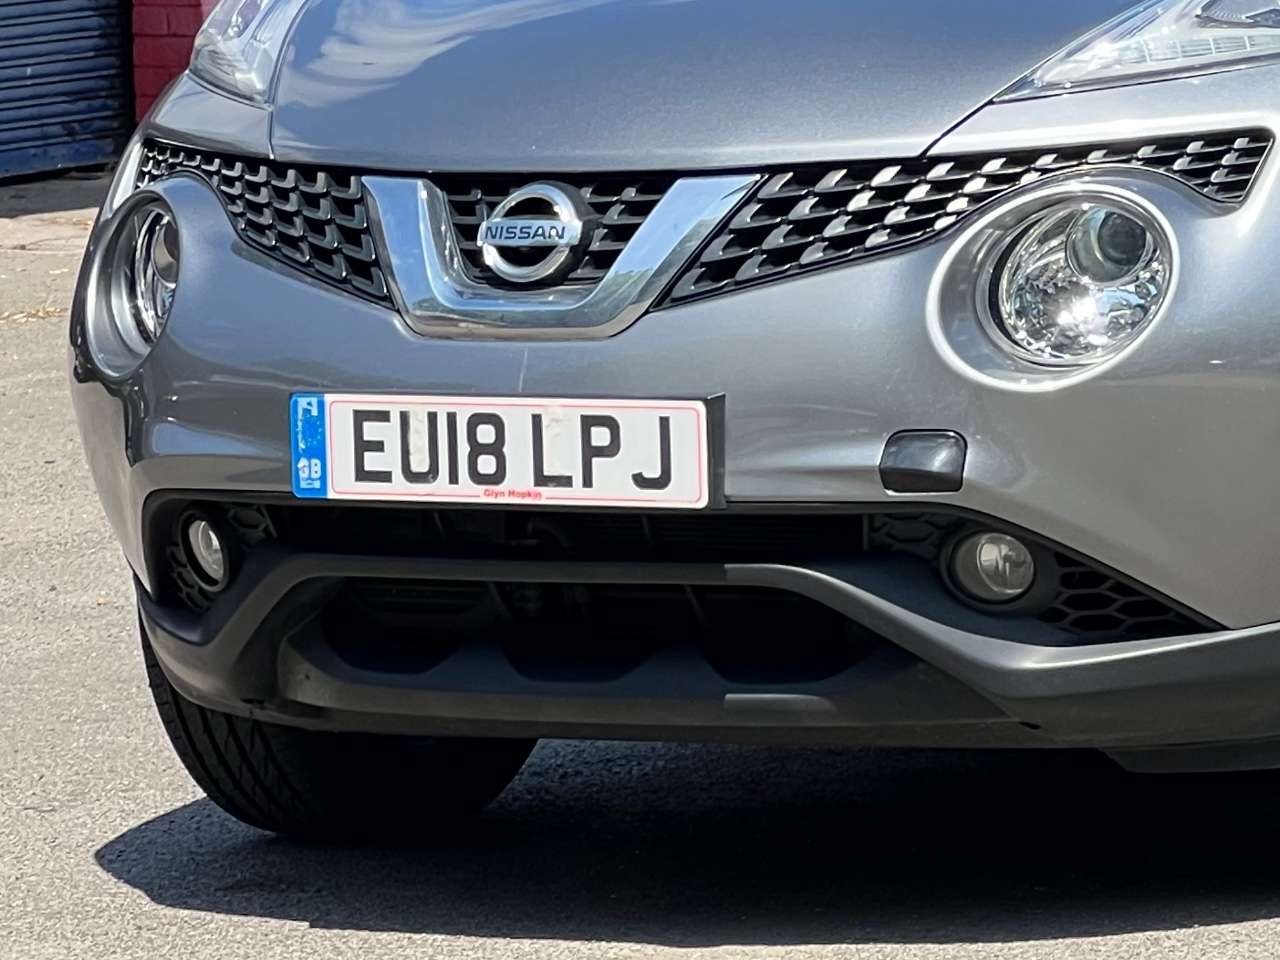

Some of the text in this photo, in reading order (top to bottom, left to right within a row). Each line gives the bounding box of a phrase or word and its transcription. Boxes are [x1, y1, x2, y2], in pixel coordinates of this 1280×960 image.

[484, 226, 566, 240] NISSAN
[352, 409, 672, 490] EU18 LPJ
